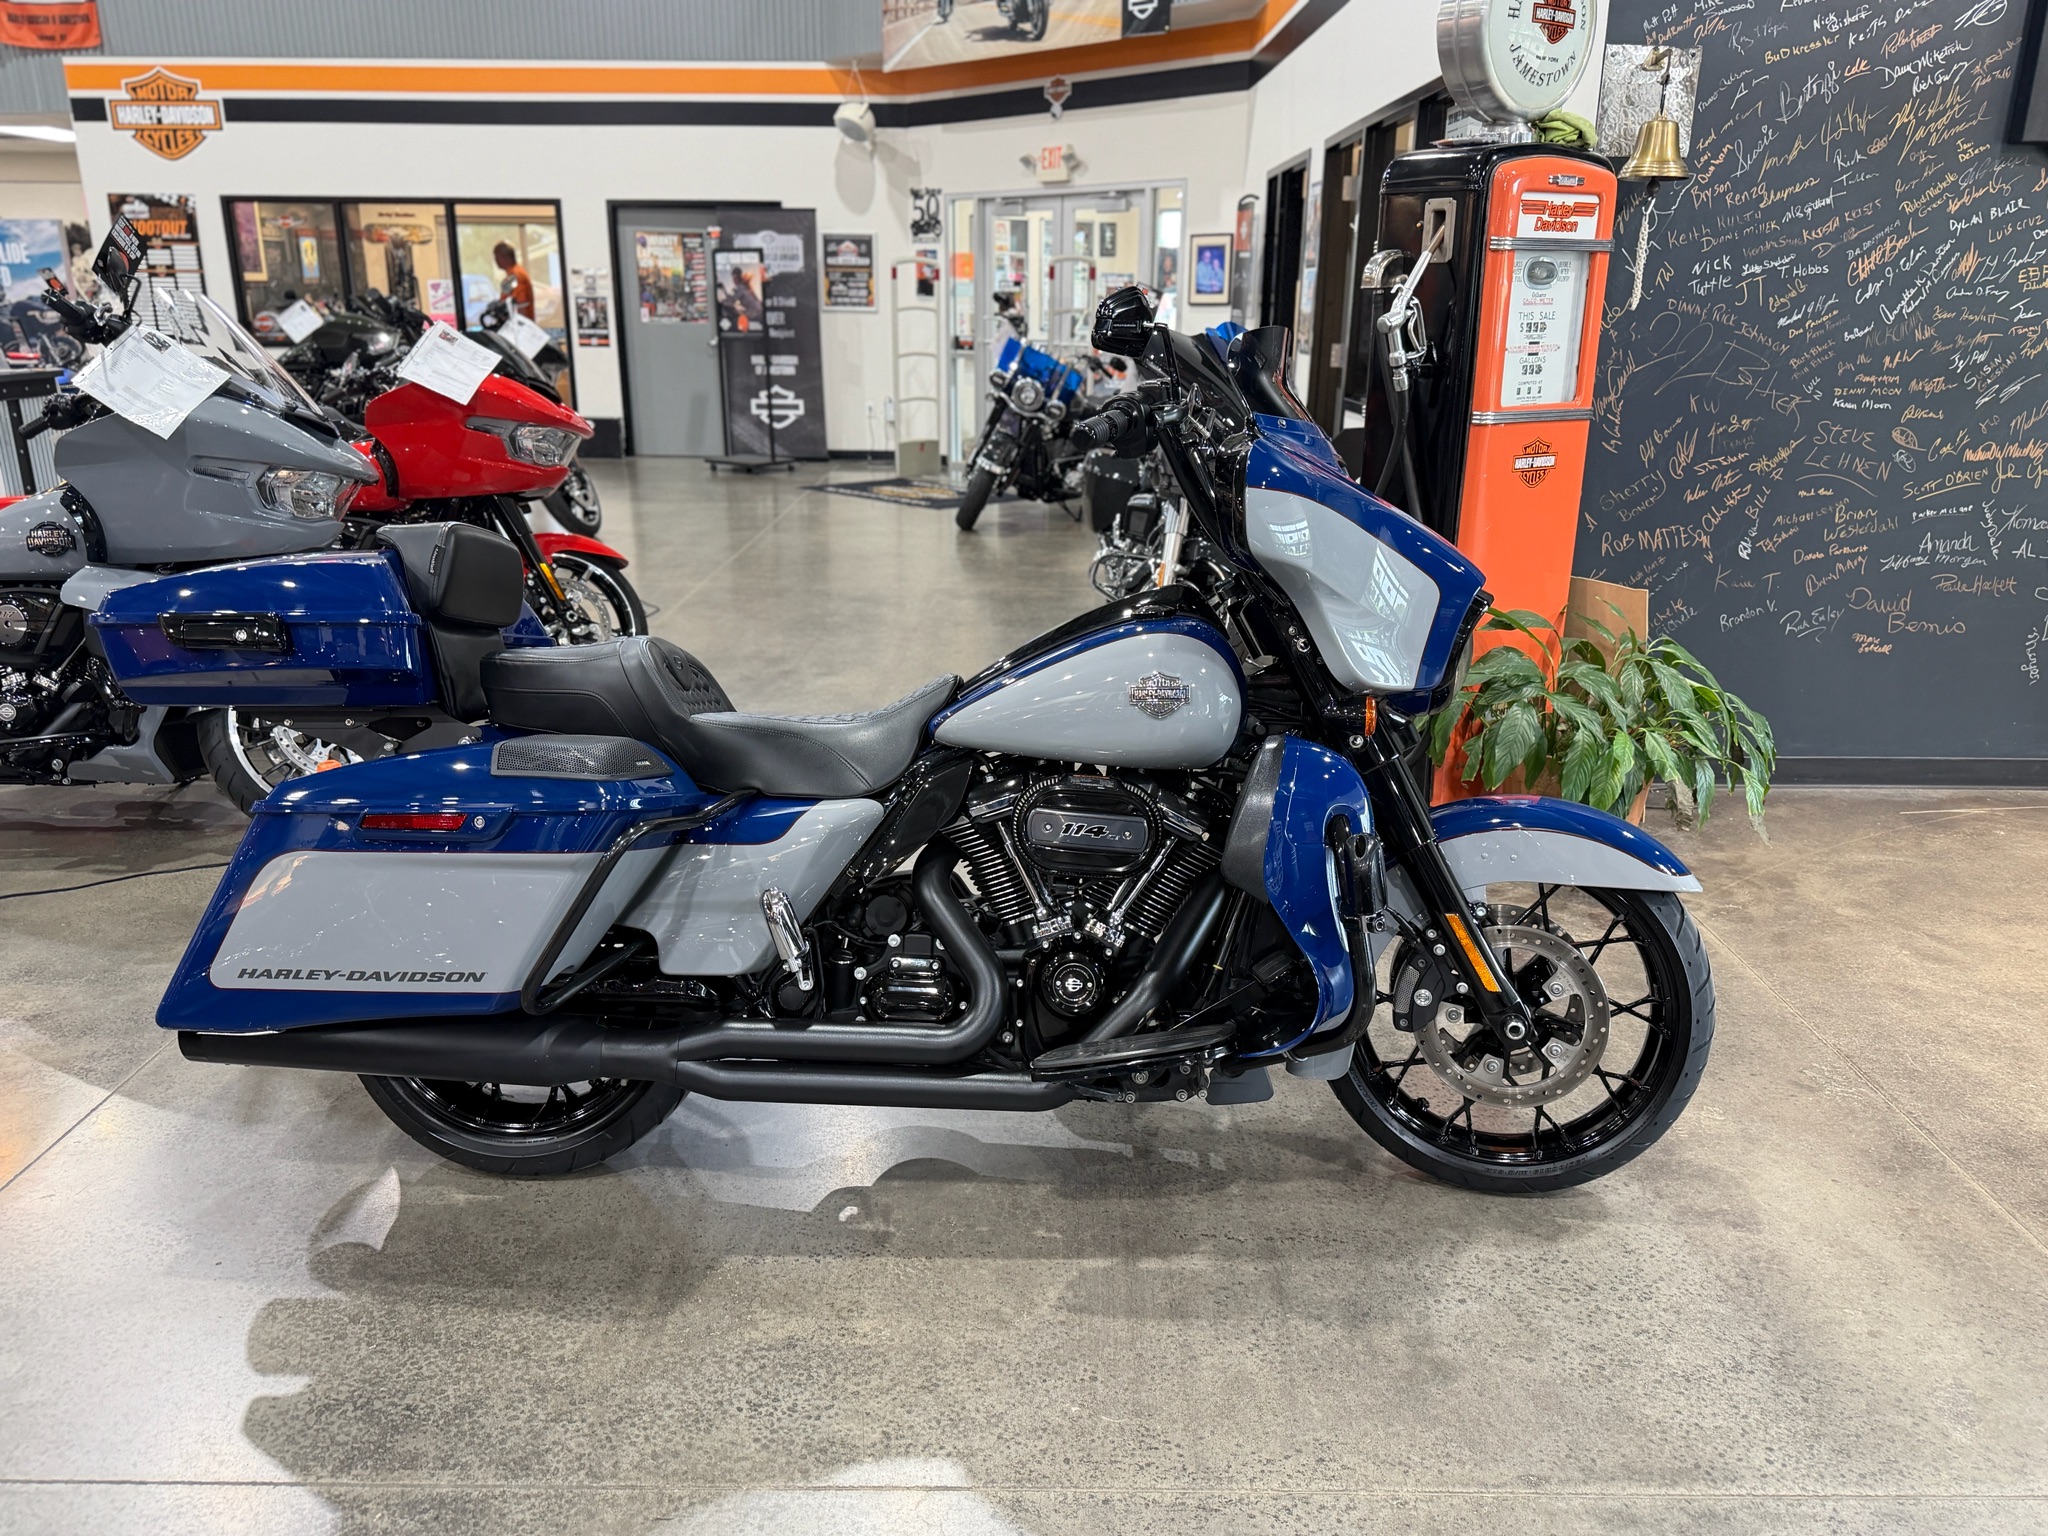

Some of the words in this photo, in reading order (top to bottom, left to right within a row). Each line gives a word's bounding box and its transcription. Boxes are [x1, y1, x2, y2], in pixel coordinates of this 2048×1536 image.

[1536, 7, 1574, 24] HARLEY-DAVIDSON
[1813, 12, 1836, 32] Nick
[1545, 26, 1565, 40] CYCLES
[1509, 43, 1576, 87] JAMESTOWN
[135, 83, 190, 99] MOTOR
[118, 105, 215, 124] HARLEY-DAVIDSON
[143, 130, 194, 155] CYCLES
[1042, 146, 1062, 170] EXIT
[1545, 201, 1574, 217] Harley
[1990, 198, 2031, 220] BLAIR
[1534, 217, 1579, 232] Davidson
[1793, 264, 1830, 277] Hobbs
[1688, 274, 1733, 296] Tuttle
[1519, 312, 1534, 320] THIS
[1539, 311, 1556, 320] SALE
[1519, 356, 1546, 364] GALLONS
[1861, 400, 1892, 410] Moon
[1526, 442, 1549, 454] MOTOR
[1515, 456, 1555, 469] HARLEY-DAVIDSON
[1523, 470, 1544, 485] CYCLES
[1945, 467, 1989, 487] O'BRIEN
[1599, 469, 1667, 511] Sherry
[28, 538, 72, 547] DAVIDSON
[1918, 531, 1980, 555] Amanda
[1845, 587, 1912, 612] David
[1720, 608, 1765, 633] Brandon
[1061, 822, 1109, 838] 114
[237, 969, 485, 982] HARLEY-DAVIDSON
